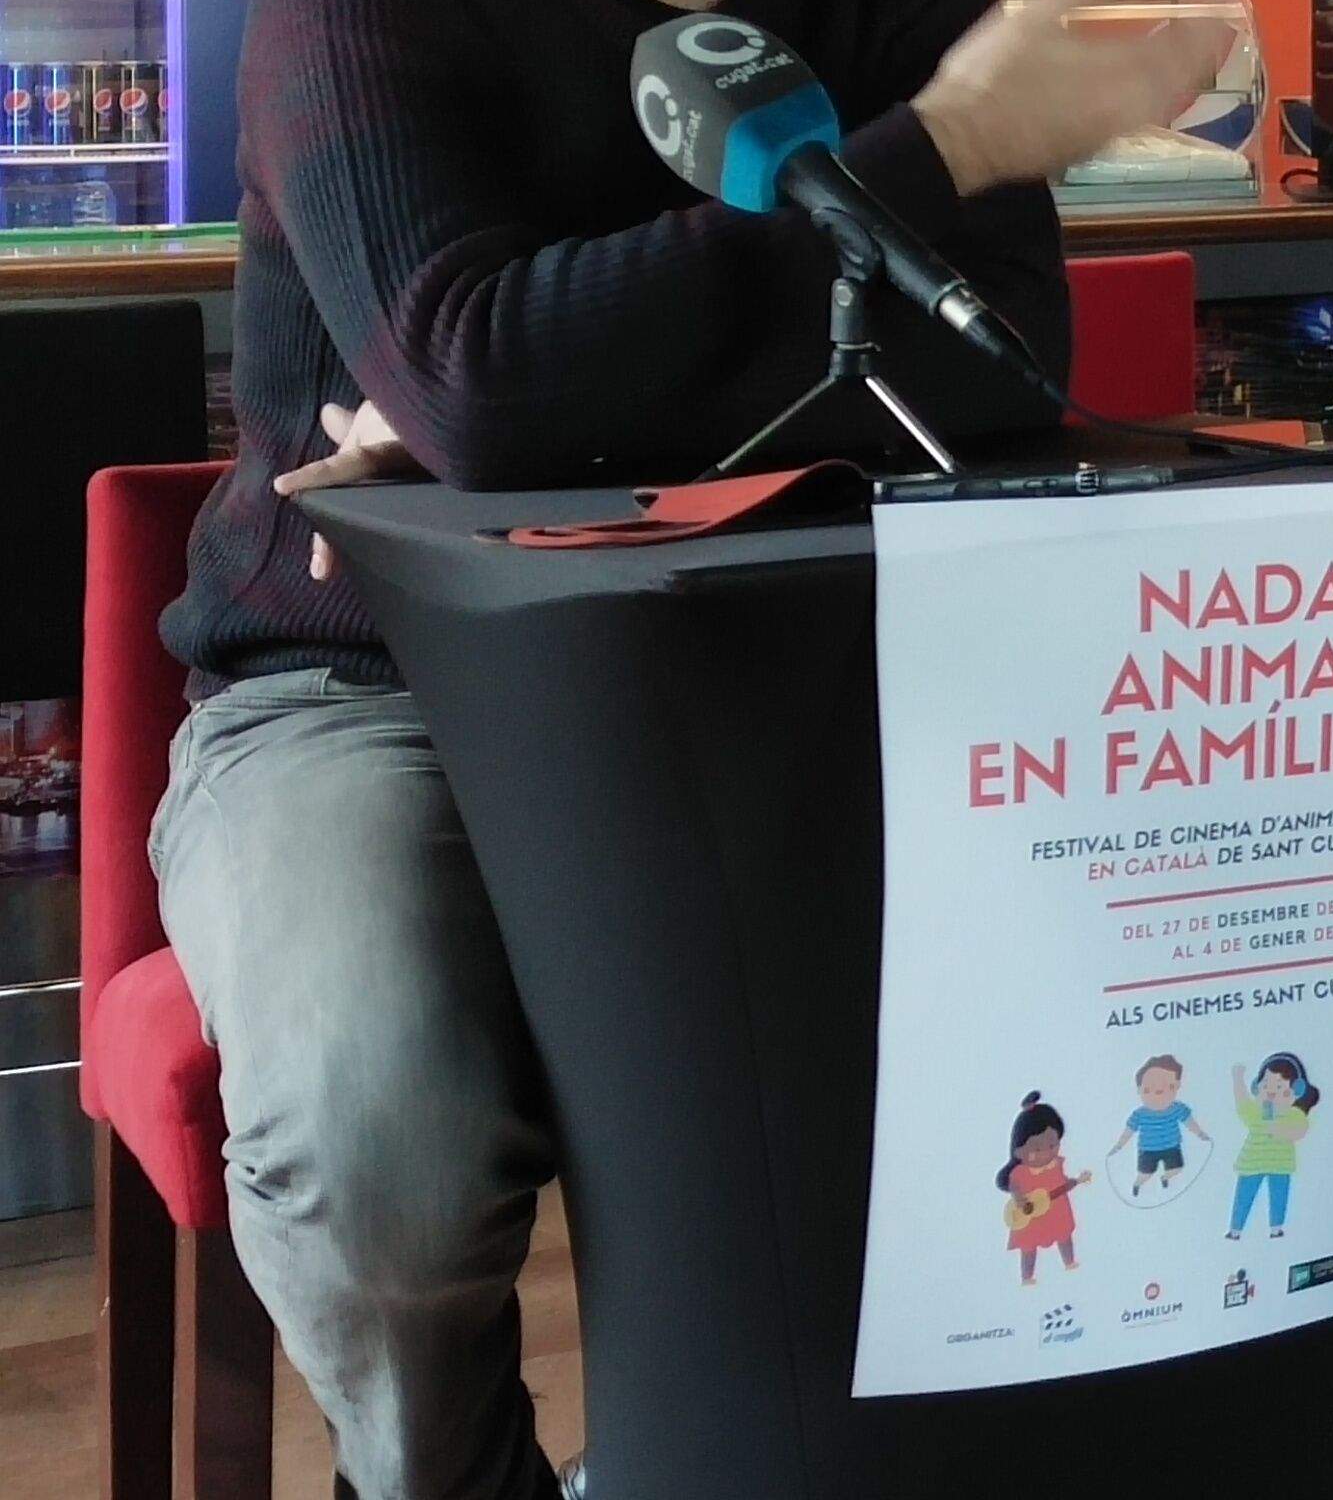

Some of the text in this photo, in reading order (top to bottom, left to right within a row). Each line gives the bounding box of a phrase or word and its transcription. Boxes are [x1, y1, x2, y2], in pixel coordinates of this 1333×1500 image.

[968, 736, 1067, 809] EN
[1032, 833, 1126, 861] FESTIVAL
[1135, 828, 1161, 850] DE
[1170, 818, 1252, 846] CINEMA
[1088, 860, 1115, 881] EN
[1125, 846, 1208, 876] CATALÀ
[1217, 845, 1243, 866] DE
[1251, 838, 1304, 862] SANT
[1122, 923, 1154, 941] DEL
[1162, 919, 1181, 936] 27
[1189, 916, 1210, 933] DE
[1217, 903, 1309, 929] DESEMBRE
[1172, 944, 1195, 961] AL
[1202, 940, 1213, 956] 4
[1220, 937, 1242, 954] DE
[1249, 929, 1306, 951] GENER
[1314, 925, 1333, 942] DE
[1105, 1005, 1144, 1030] ALS
[1152, 992, 1245, 1022] CINEMES
[1252, 983, 1305, 1009] SANT
